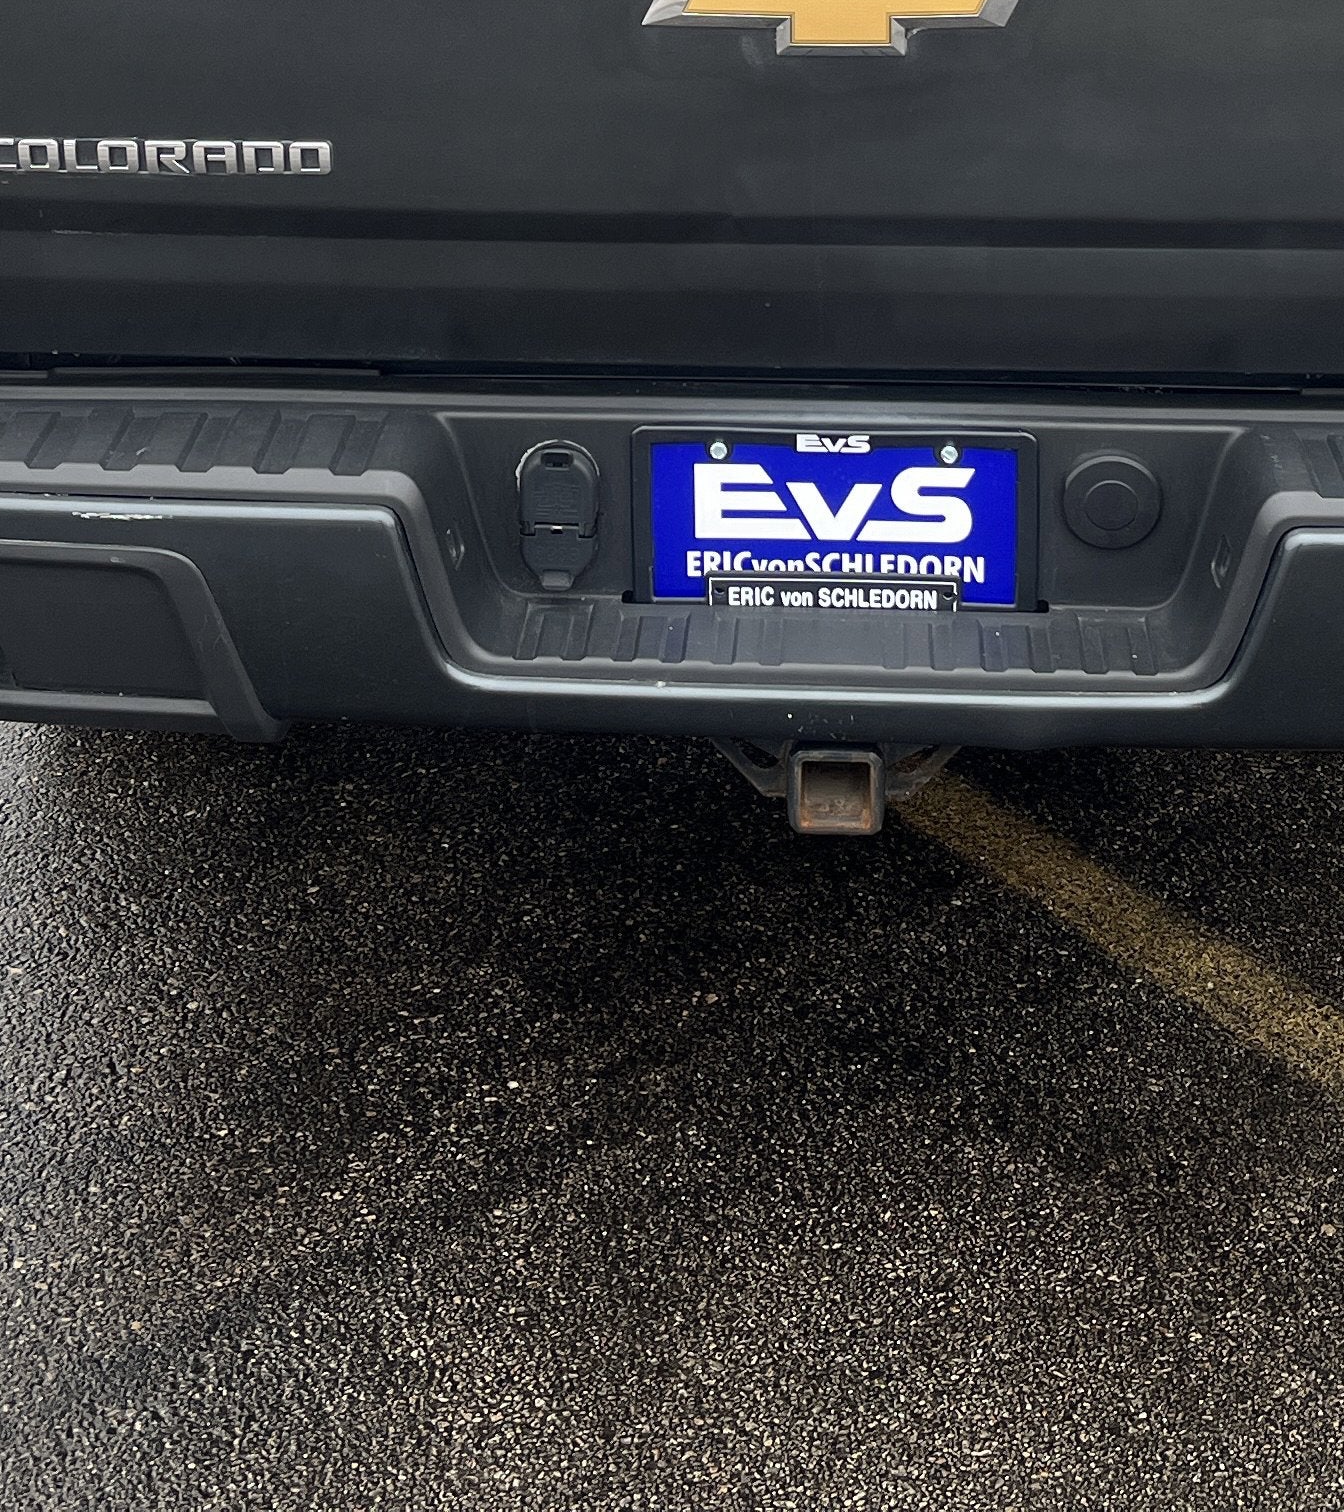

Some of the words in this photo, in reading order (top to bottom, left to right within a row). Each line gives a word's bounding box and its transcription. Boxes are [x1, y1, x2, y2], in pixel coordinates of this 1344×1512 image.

[796, 433, 871, 454] EvS
[694, 463, 976, 543] EvS
[728, 586, 775, 606] ERIC
[780, 590, 813, 607] von
[818, 588, 938, 611] SCHLEDORN
